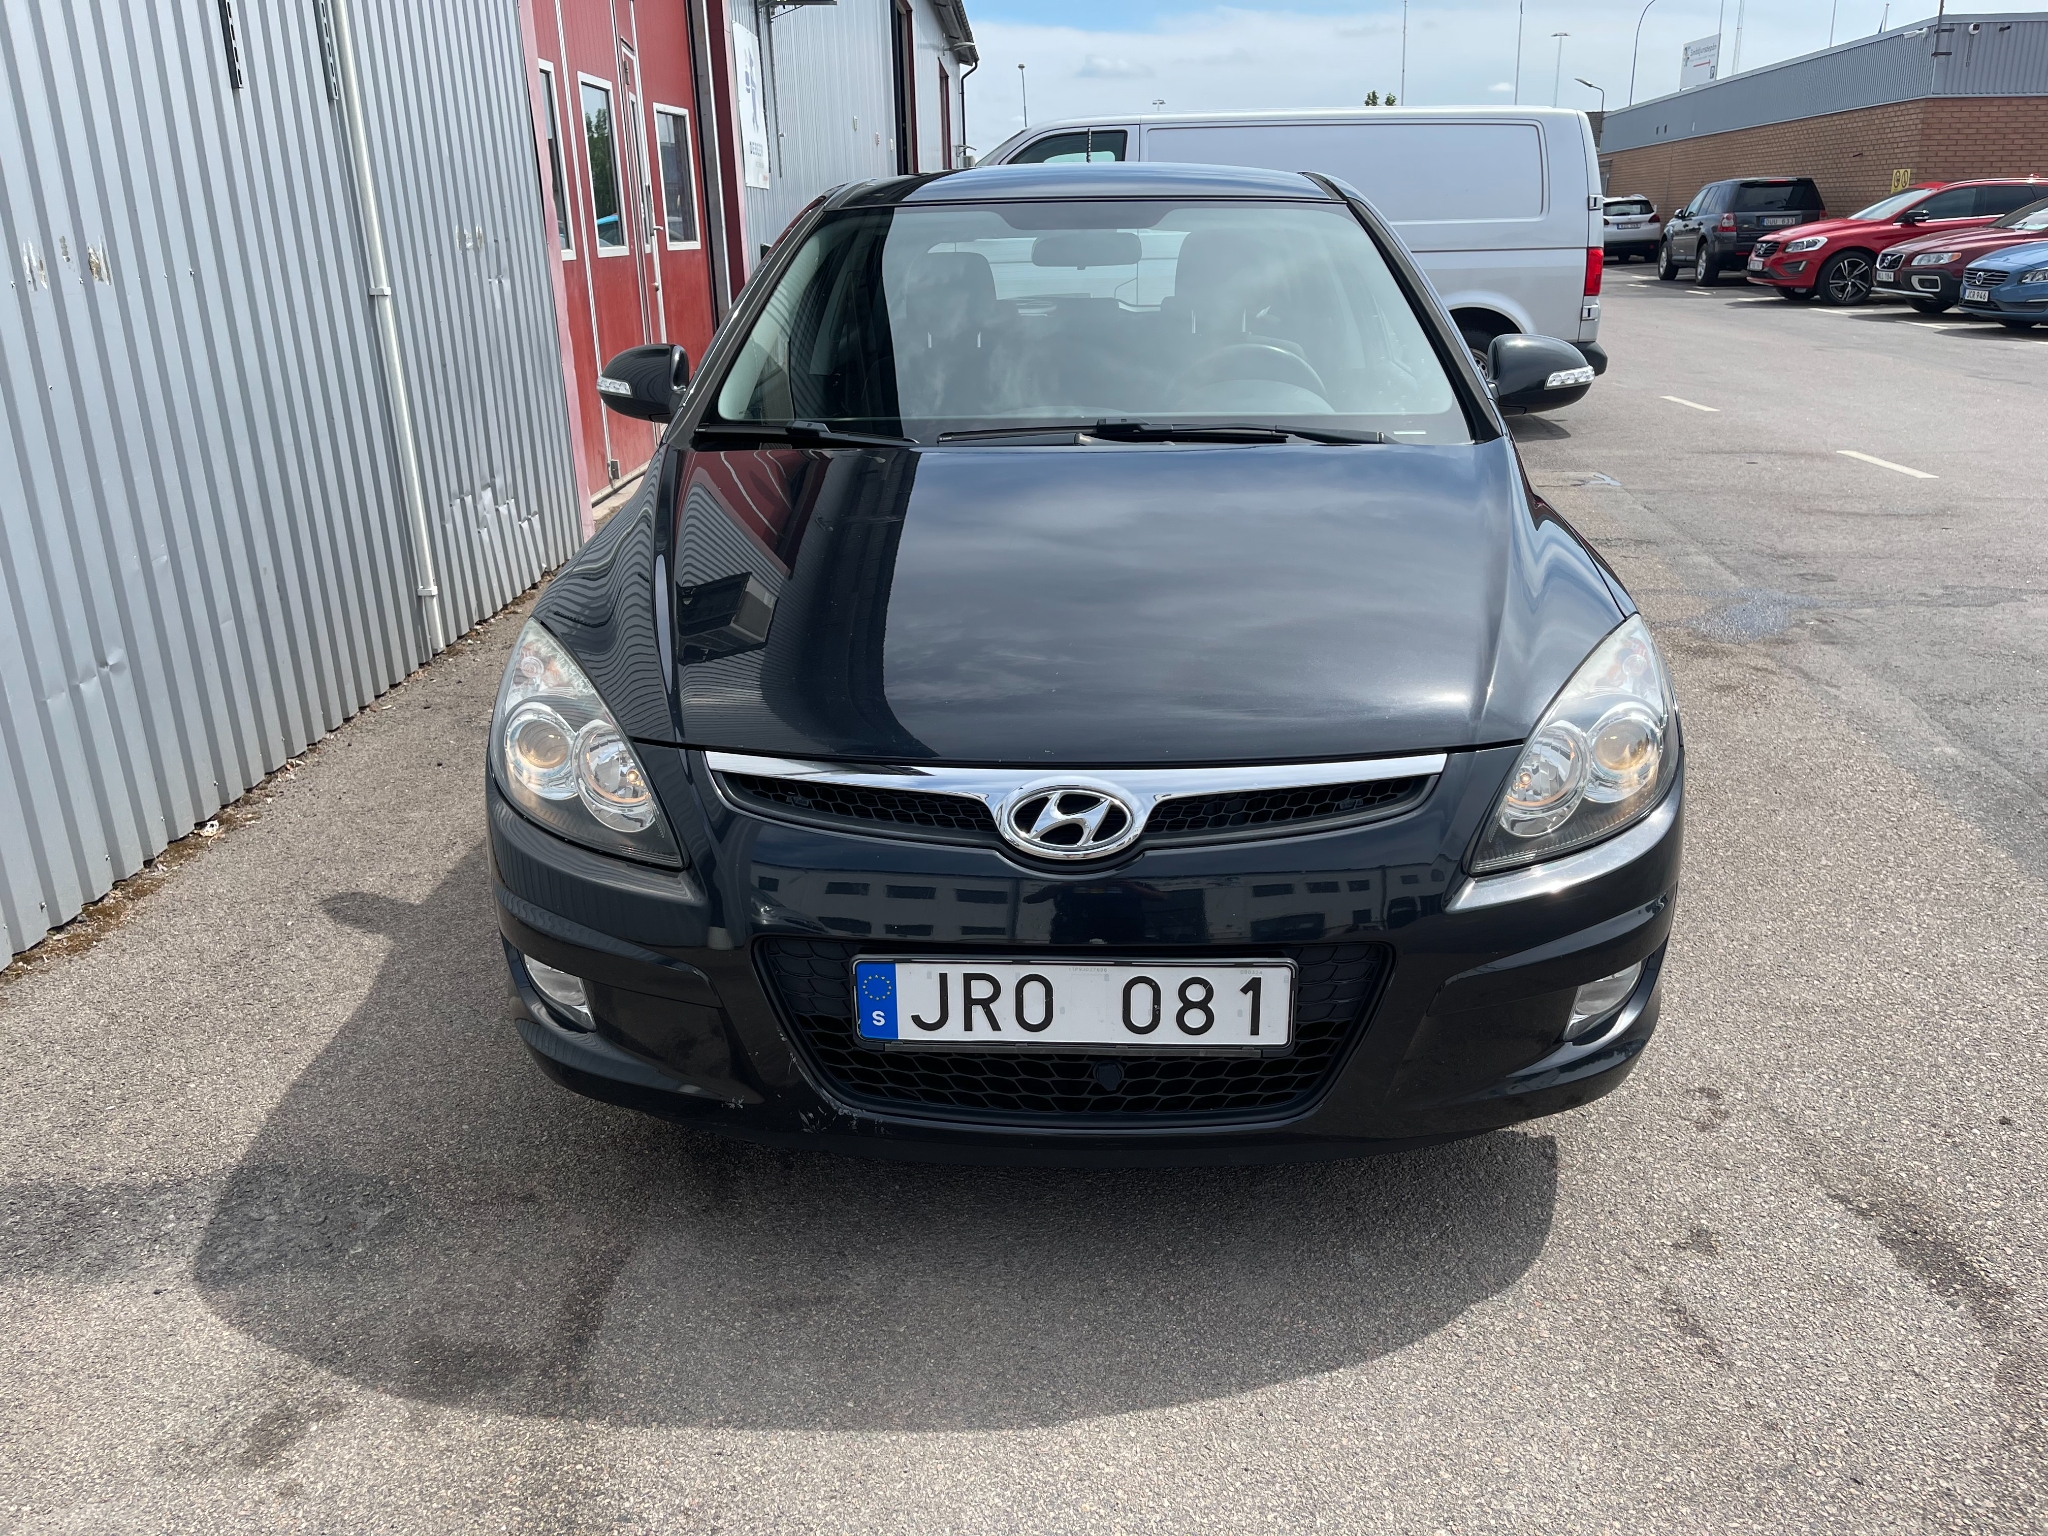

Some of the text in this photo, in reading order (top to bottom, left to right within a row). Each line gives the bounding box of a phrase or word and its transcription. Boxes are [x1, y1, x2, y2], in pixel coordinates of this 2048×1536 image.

[872, 1009, 886, 1027] S
[910, 972, 1262, 1036] JRO 081
